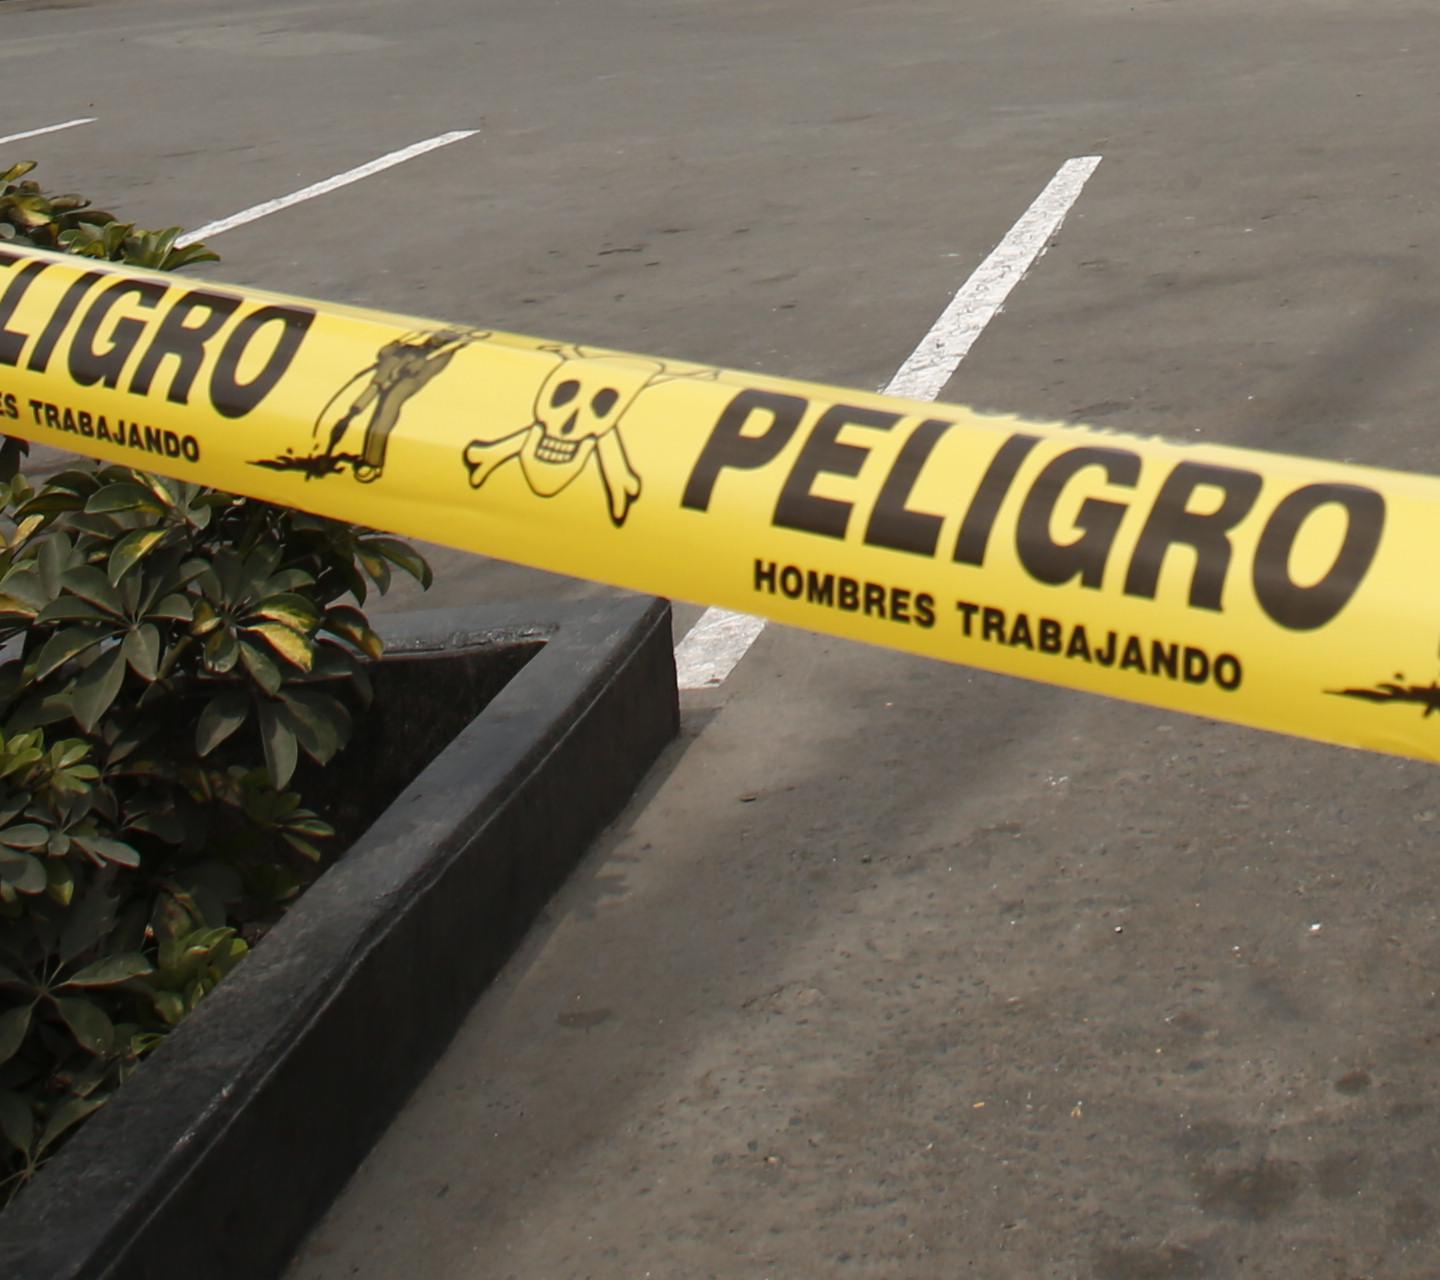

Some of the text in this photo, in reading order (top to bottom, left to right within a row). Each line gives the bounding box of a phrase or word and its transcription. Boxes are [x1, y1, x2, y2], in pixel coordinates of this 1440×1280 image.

[29, 398, 201, 464] TRABAJANDO
[679, 387, 1389, 634] PELIGRO
[753, 558, 1245, 693] HOMBRES TRABAJANDO
